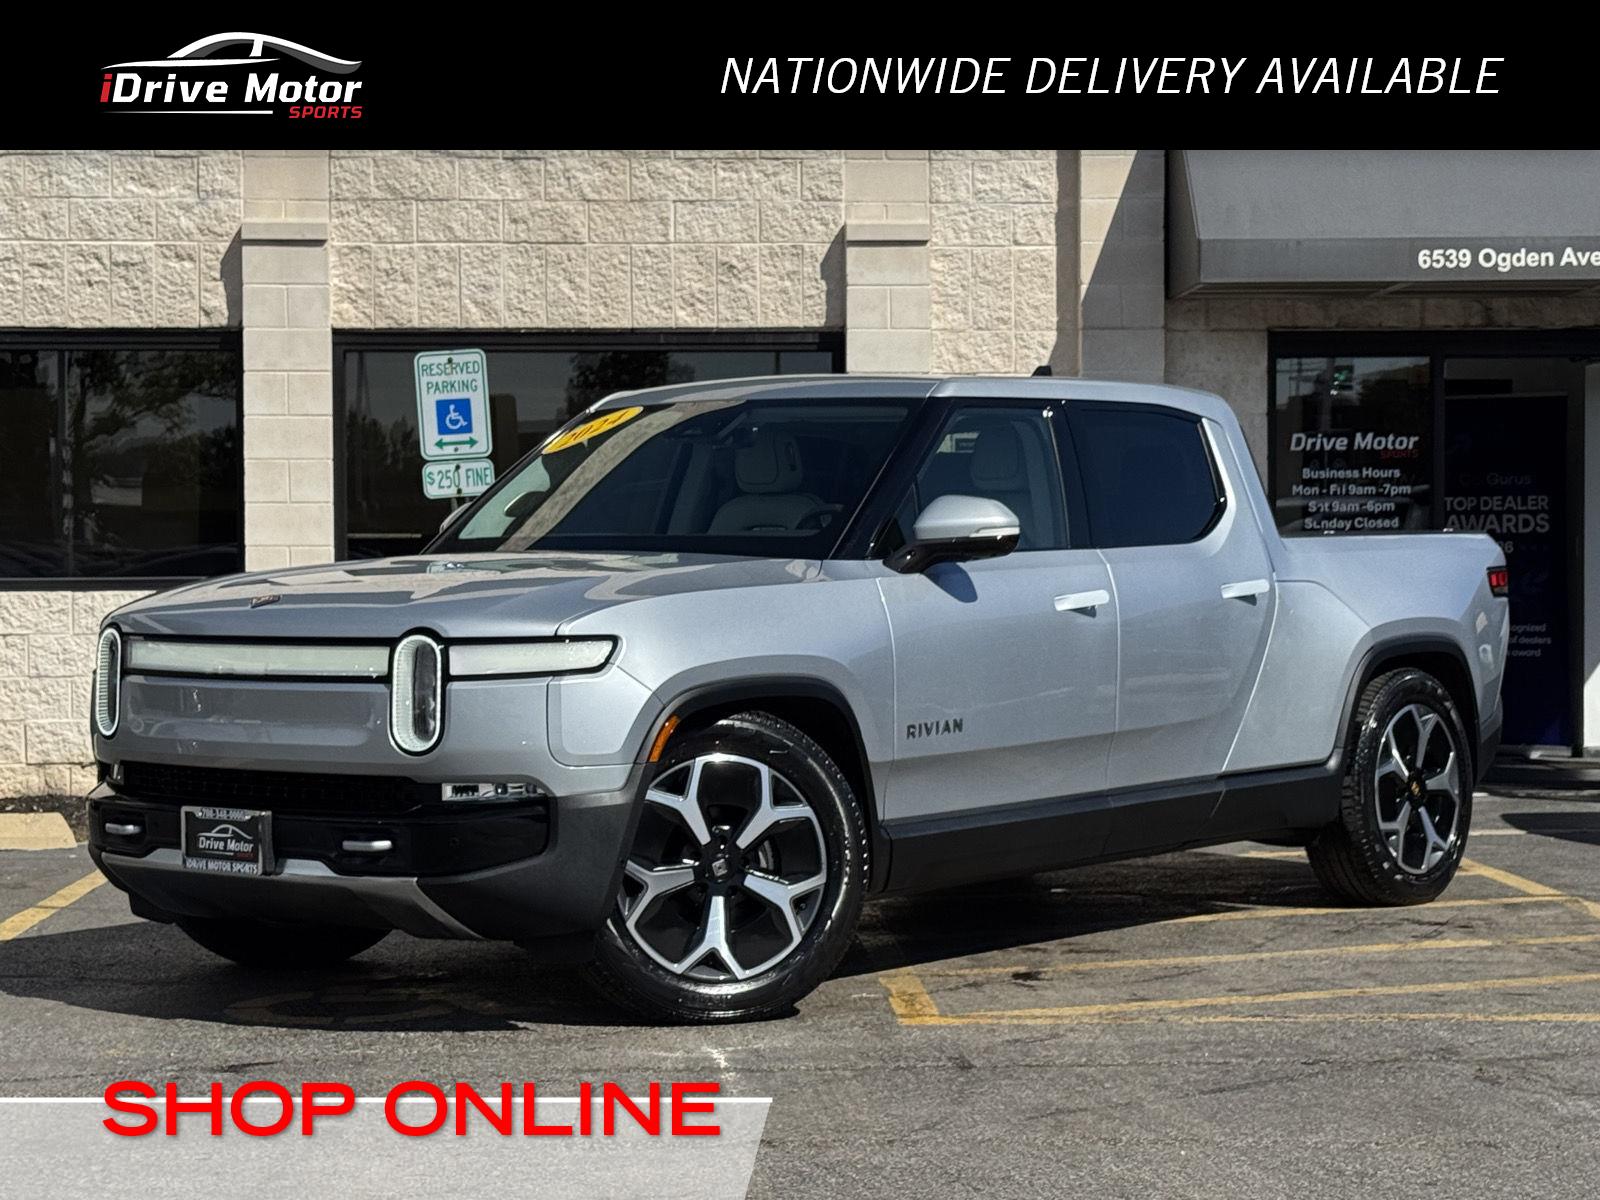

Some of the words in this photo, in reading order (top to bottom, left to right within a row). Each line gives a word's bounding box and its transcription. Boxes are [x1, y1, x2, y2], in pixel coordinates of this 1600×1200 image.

[1417, 248, 1472, 269] 6539
[1478, 247, 1555, 273] Ogden
[1560, 246, 1600, 267] Ave
[421, 360, 480, 377] RESERVED
[426, 379, 478, 395] PARKING
[1354, 432, 1420, 450] Motor
[426, 468, 462, 490] $250
[466, 466, 491, 487] FINE
[1302, 467, 1360, 479] Business
[1362, 467, 1401, 478] Hours
[1292, 484, 1320, 496] Mon
[1348, 484, 1376, 496] 9am
[1332, 500, 1360, 512] 9am
[1444, 496, 1477, 511] TOP
[1480, 495, 1549, 511] DEALER
[1304, 517, 1352, 531] Sunday
[1355, 517, 1400, 529] Closed
[1446, 513, 1550, 533] AWARDS
[906, 718, 964, 739] RIVIAN
[226, 838, 255, 852] Motor
[208, 859, 232, 872] MOTOR
[232, 861, 258, 874] SPORTS
